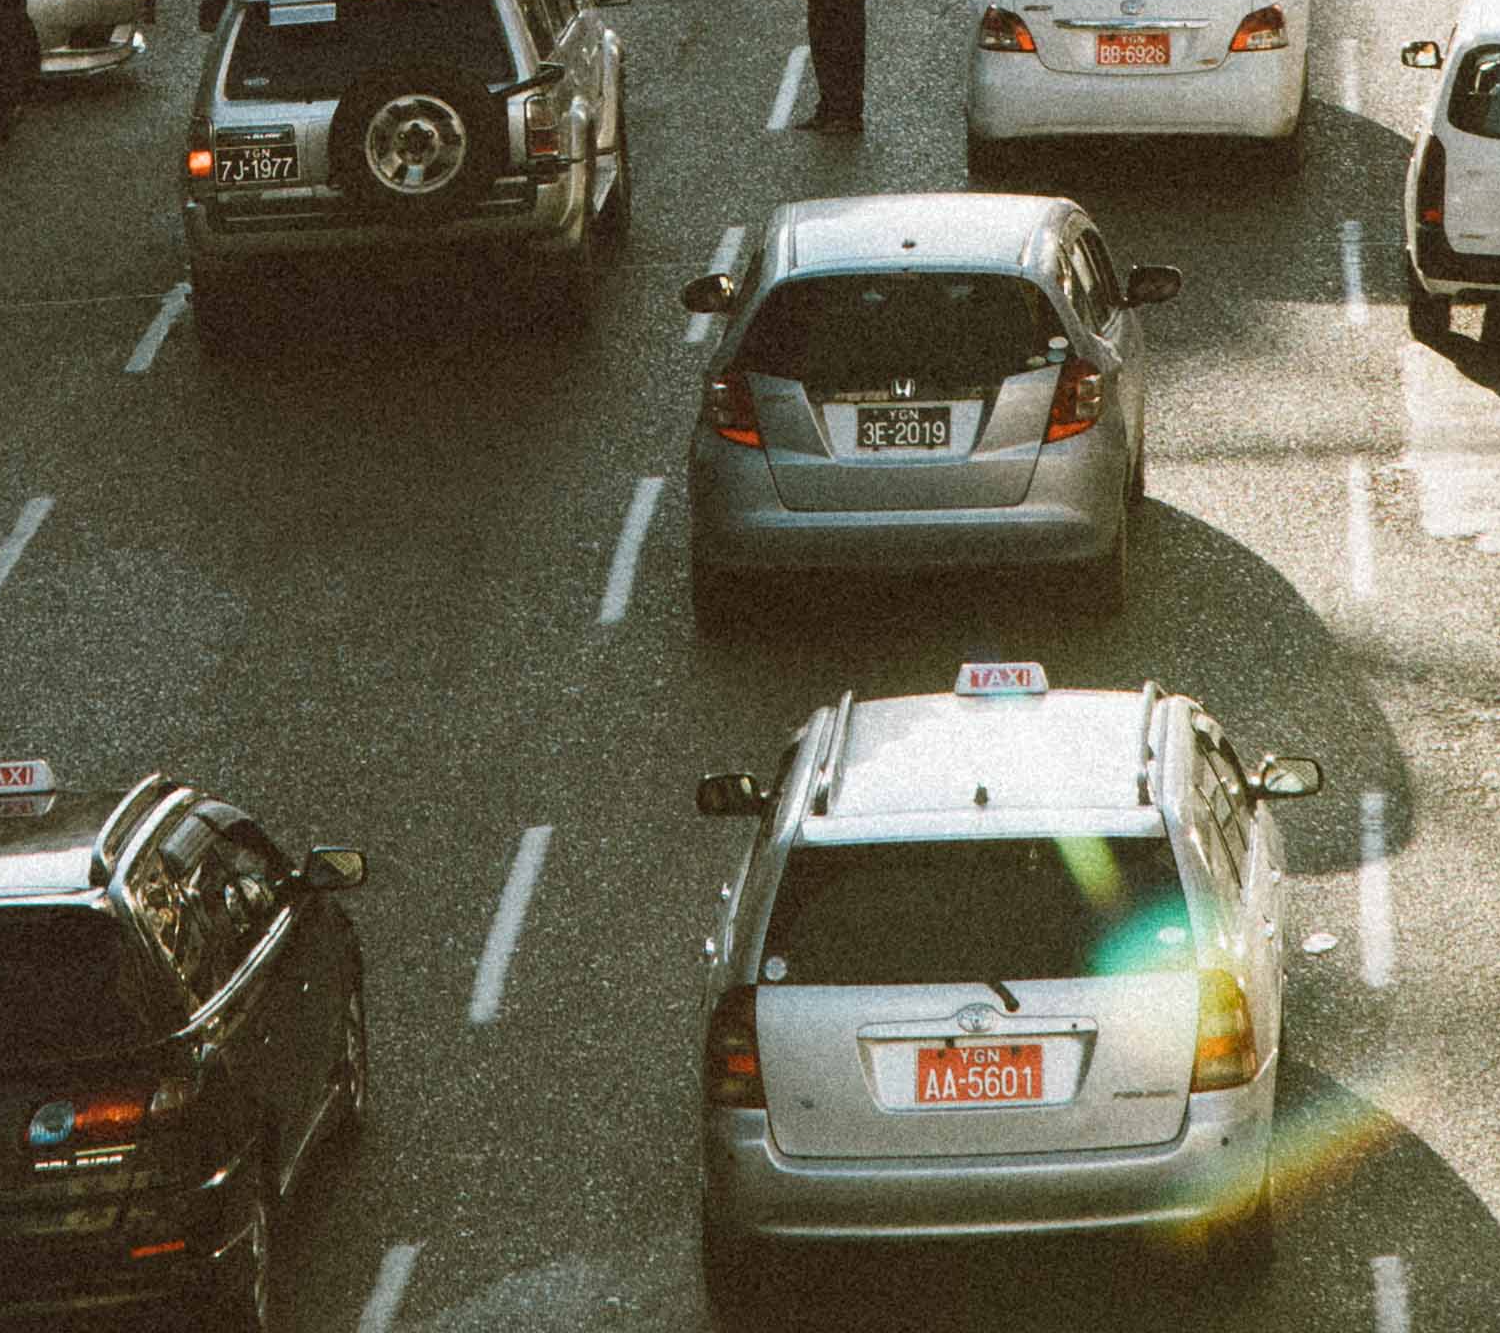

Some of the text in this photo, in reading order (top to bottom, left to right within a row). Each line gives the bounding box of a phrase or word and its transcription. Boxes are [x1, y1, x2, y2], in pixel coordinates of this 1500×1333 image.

[244, 148, 271, 159] YGN
[220, 158, 293, 181] 7J-1977
[889, 410, 919, 421] YGN
[863, 422, 946, 446] 3E-2019
[972, 668, 1031, 688] TAXI
[960, 1050, 1001, 1064] YGN
[924, 1065, 1034, 1100] AA-5601
